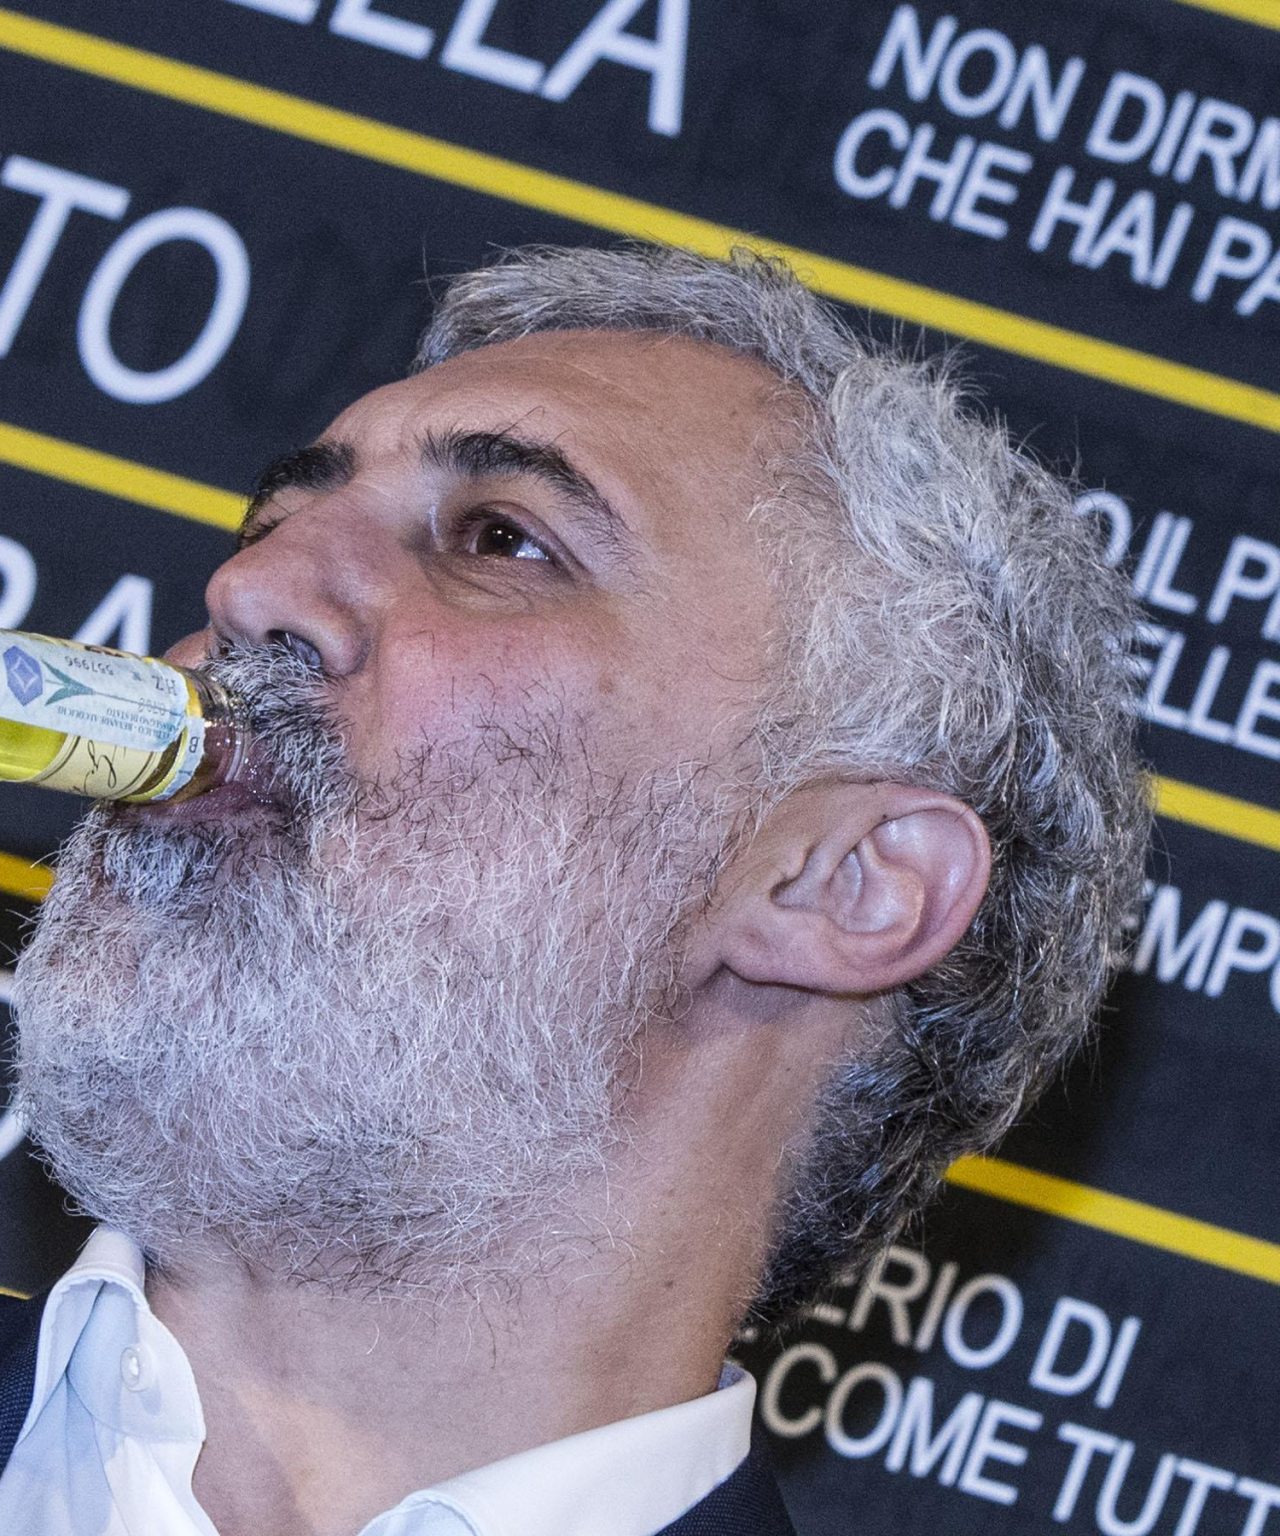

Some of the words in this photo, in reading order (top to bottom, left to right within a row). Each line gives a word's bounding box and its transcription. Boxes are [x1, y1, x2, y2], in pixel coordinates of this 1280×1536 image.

[867, 3, 1085, 141] NON
[832, 108, 1033, 240] CHE
[1029, 165, 1195, 289] HAI
[1132, 511, 1197, 614] IL
[1206, 534, 1280, 642] P
[1029, 1296, 1142, 1410] DI
[761, 1342, 1043, 1506] COME
